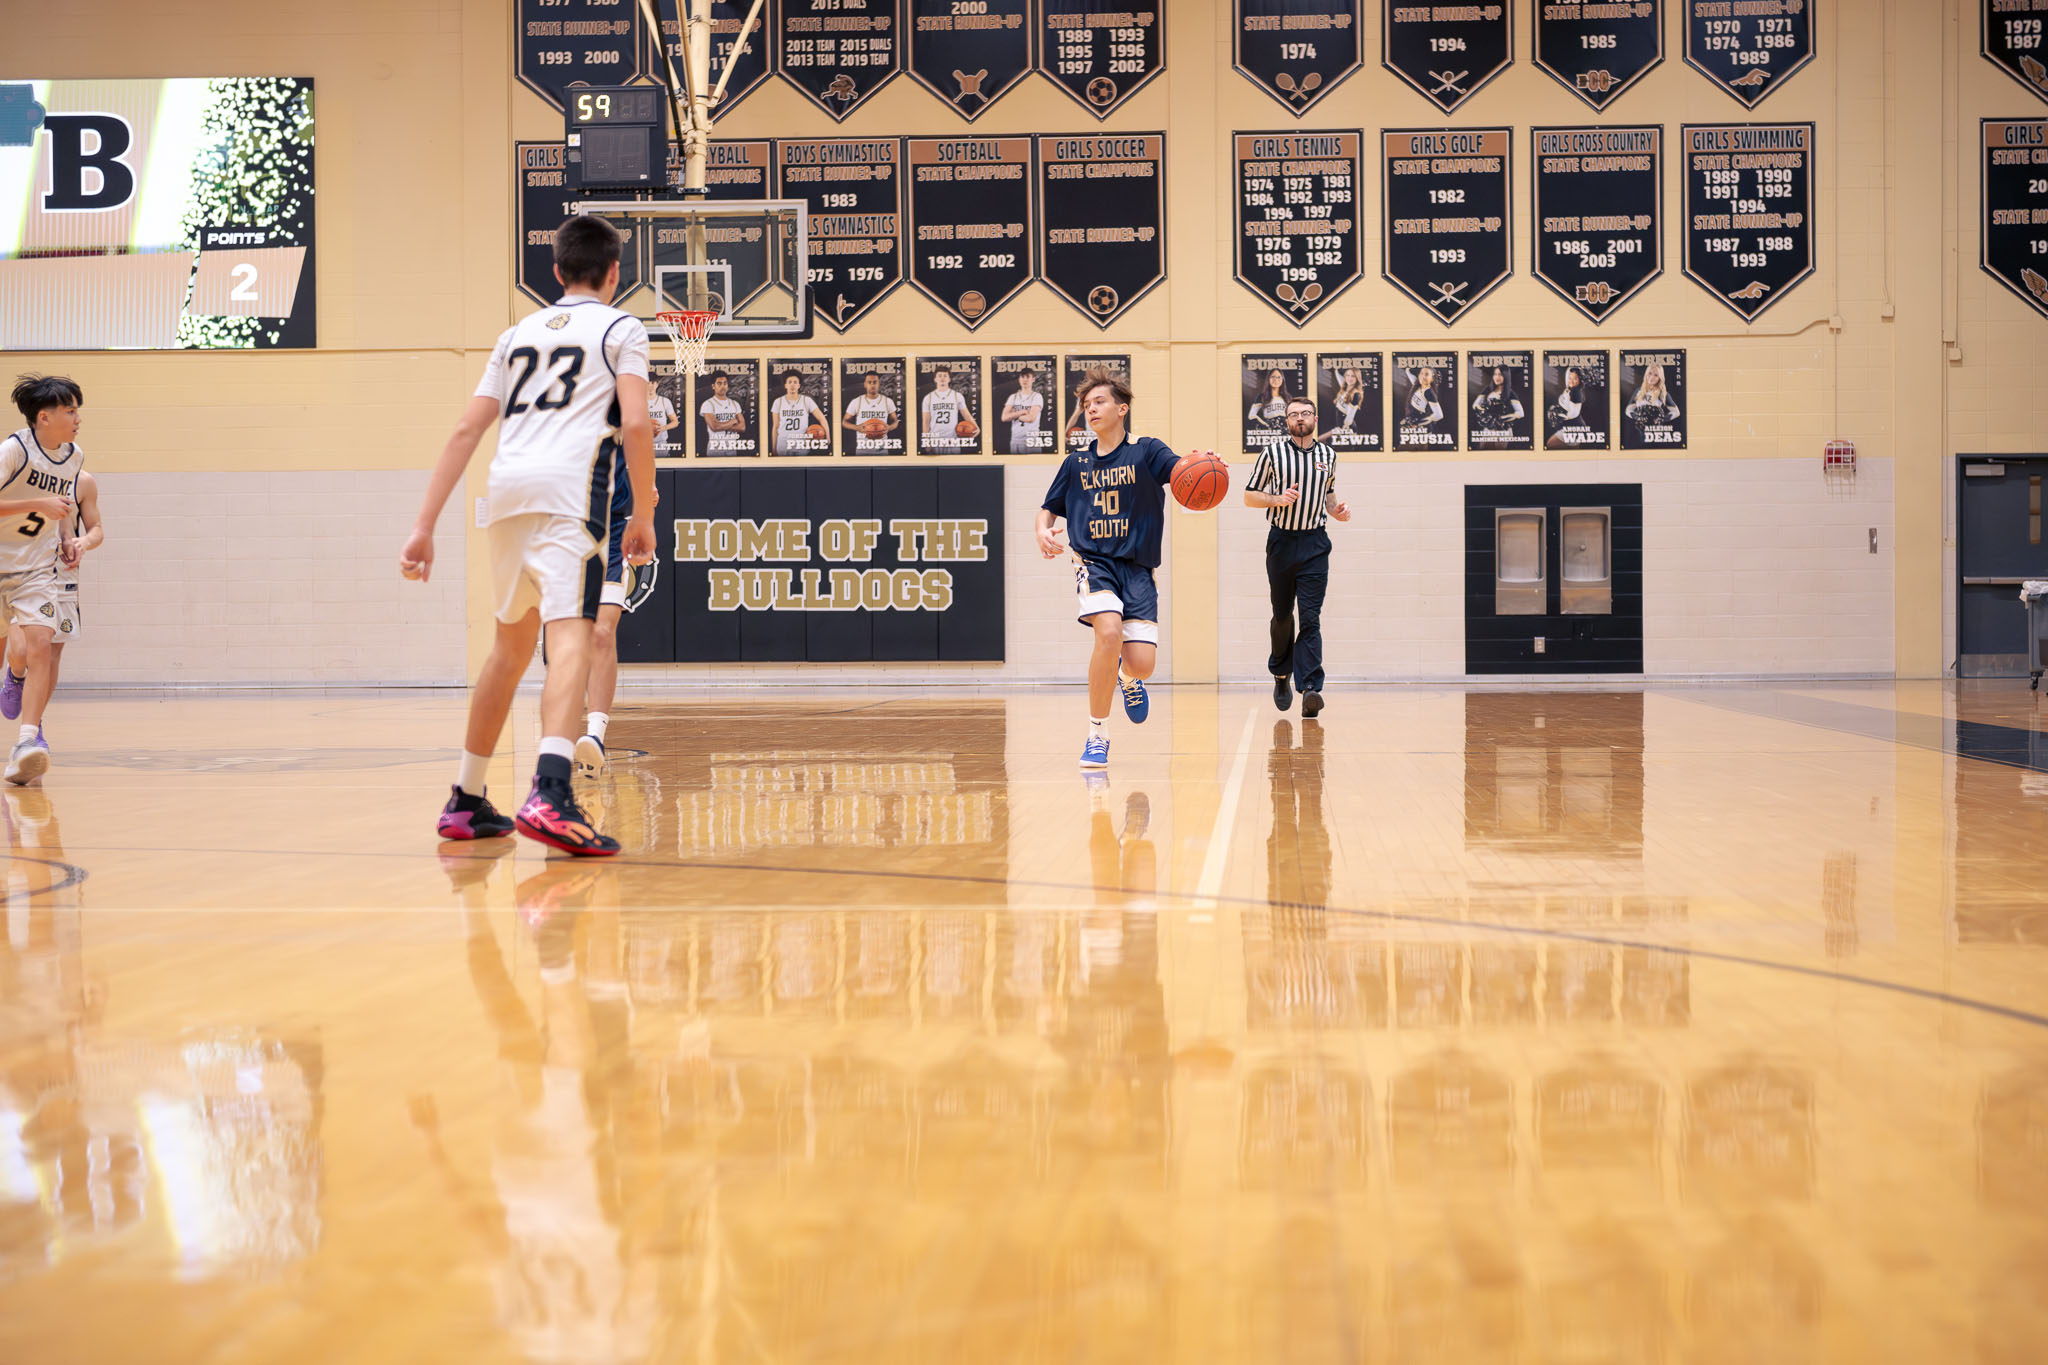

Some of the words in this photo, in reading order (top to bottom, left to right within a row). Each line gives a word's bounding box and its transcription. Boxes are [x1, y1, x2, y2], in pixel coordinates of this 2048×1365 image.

[952, 1, 987, 15] 2000
[1544, 5, 1580, 20] STATE
[1582, 2, 1652, 19] RUNNER-UP
[1695, 1, 1731, 18] STATE
[1733, 0, 1803, 16] RUNNER-UP
[1993, 0, 2029, 12] STATE
[1048, 14, 1084, 29] STATE
[1086, 12, 1154, 28] RUNNER-UP
[1394, 8, 1430, 22] STATE
[1432, 6, 1502, 21] RUNNER-UP
[527, 22, 561, 35] STATE
[564, 20, 630, 35] RUNNER-UP
[787, 17, 821, 32] STATE
[824, 16, 890, 30] RUNNER-UP
[917, 17, 952, 30] STATE
[954, 15, 1022, 30] RUNNER-UP
[1244, 16, 1280, 30] STATE
[1282, 14, 1351, 30] RUNNER-UP
[1704, 21, 1740, 34] 1970
[1757, 19, 1792, 32] 1971
[2004, 20, 2042, 34] 1979
[1057, 30, 1093, 43] 1989
[1109, 28, 1145, 42] 1993
[1580, 35, 1616, 49] 1985
[1704, 37, 1740, 50] 1974
[1754, 34, 1795, 48] 1986
[2004, 35, 2041, 49] 1987
[786, 40, 813, 52] 2012
[816, 40, 835, 51] TEAM
[840, 39, 867, 51] 2015
[1058, 46, 1093, 58] 1995
[1109, 44, 1145, 57] 1996
[1280, 44, 1316, 59] 1974
[1430, 38, 1467, 52] 1994
[538, 52, 572, 64] 1993
[584, 51, 620, 64] 2000
[786, 55, 813, 66] 2013
[817, 55, 835, 66] TEAM
[840, 54, 868, 66] 2019
[870, 53, 888, 65] TEAM
[1730, 51, 1770, 64] 1989
[1058, 61, 1092, 74] 1997
[1109, 60, 1145, 73] 2002
[577, 95, 610, 120] 59
[1541, 135, 1569, 153] GIRLS
[1572, 134, 1603, 152] CROSS
[1606, 132, 1652, 152] COUNTRY
[1692, 132, 1729, 150] GIRLS
[1733, 130, 1803, 149] SWIMMING
[2004, 126, 2043, 144] GIRLS
[937, 141, 1002, 161] SOFTBALL
[1056, 141, 1093, 160] GIRLS
[1097, 139, 1145, 158] SOCCER
[1253, 139, 1290, 157] GIRLS
[1294, 138, 1341, 156] TENNIS
[1410, 136, 1447, 154] GIRLS
[1450, 135, 1482, 153] GOLF
[526, 149, 558, 167] GIRLS
[787, 145, 818, 164] BOYS
[820, 142, 892, 162] GYMNASTICS
[1993, 150, 2029, 164] STATE
[41, 111, 136, 213] B
[1244, 162, 1280, 176] STATE
[1282, 160, 1350, 175] CHAMPIONS
[1394, 161, 1429, 174] STATE
[1431, 158, 1500, 173] CHAMPIONS
[1544, 158, 1579, 172] STATE
[1582, 156, 1650, 171] CHAMPIONS
[1694, 155, 1730, 170] STATE
[1732, 154, 1802, 168] CHAMPIONS
[786, 168, 822, 182] STATE
[824, 166, 892, 181] RUNNER-UP
[918, 167, 953, 182] STATE
[954, 165, 1022, 180] CHAMPIONS
[1048, 165, 1084, 179] STATE
[1085, 162, 1153, 178] CHAMPIONS
[1704, 171, 1740, 184] 1989
[1756, 170, 1792, 182] 1990
[528, 172, 562, 186] STATE
[1244, 179, 1274, 191] 1974
[1283, 178, 1312, 190] 1975
[1323, 176, 1351, 188] 1981
[1244, 194, 1274, 206] 1984
[1283, 192, 1312, 204] 1992
[1322, 191, 1351, 203] 1993
[1428, 190, 1464, 203] 1982
[1704, 186, 1739, 198] 1991
[1756, 184, 1792, 197] 1992
[821, 194, 857, 208] 1983
[1730, 200, 1766, 213] 1994
[1264, 208, 1293, 220] 1994
[1304, 206, 1332, 218] 1997
[1993, 210, 2029, 224] STATE
[818, 216, 894, 236] GYMNASTICS
[1246, 221, 1281, 236] STATE
[1282, 220, 1351, 234] RUNNER-UP
[1394, 220, 1430, 234] STATE
[1432, 218, 1501, 232] RUNNER-UP
[1544, 218, 1580, 232] STATE
[1582, 216, 1651, 230] RUNNER-UP
[1694, 215, 1730, 230] STATE
[1733, 214, 1802, 228] RUNNER-UP
[208, 232, 265, 244] POINTS
[918, 225, 953, 240] STATE
[955, 223, 1023, 238] RUNNER-UP
[1049, 229, 1085, 244] STATE
[1087, 227, 1154, 242] RUNNER-UP
[825, 239, 893, 254] RUNNER-UP
[1256, 238, 1291, 250] 1976
[1306, 236, 1342, 249] 1979
[1554, 241, 1590, 254] 1986
[1608, 240, 1642, 252] 2001
[1704, 238, 1740, 252] 1987
[1757, 238, 1793, 250] 1988
[928, 256, 963, 269] 1992
[979, 254, 1015, 268] 2002
[1256, 254, 1292, 266] 1980
[1306, 252, 1342, 265] 1982
[1430, 250, 1466, 263] 1993
[1580, 254, 1616, 268] 2003
[1731, 254, 1767, 267] 1993
[848, 267, 884, 281] 1976
[1281, 268, 1317, 281] 1996
[230, 264, 258, 300] 2
[1247, 359, 1297, 370] BURKE
[1322, 358, 1372, 369] BURKE
[1397, 357, 1448, 368] BURKE
[1472, 356, 1523, 367] BURKE
[504, 346, 585, 419] 23
[787, 439, 828, 449] PRICE
[856, 439, 902, 449] ROPER
[921, 438, 977, 447] RUMMEL
[1026, 437, 1052, 447] SAS
[1332, 435, 1378, 445] LEWIS
[1400, 434, 1453, 444] PRUSIA
[1563, 433, 1605, 443] WADE
[1644, 432, 1681, 442] DEAS
[710, 440, 755, 450] PARKS
[1078, 464, 1136, 490] ELKHORN
[1094, 490, 1119, 516] 40
[1089, 519, 1128, 539] SOUTH
[674, 519, 812, 561] HOME
[820, 519, 882, 561] OF
[890, 519, 988, 561] THE
[708, 568, 952, 611] BULLDOGS
